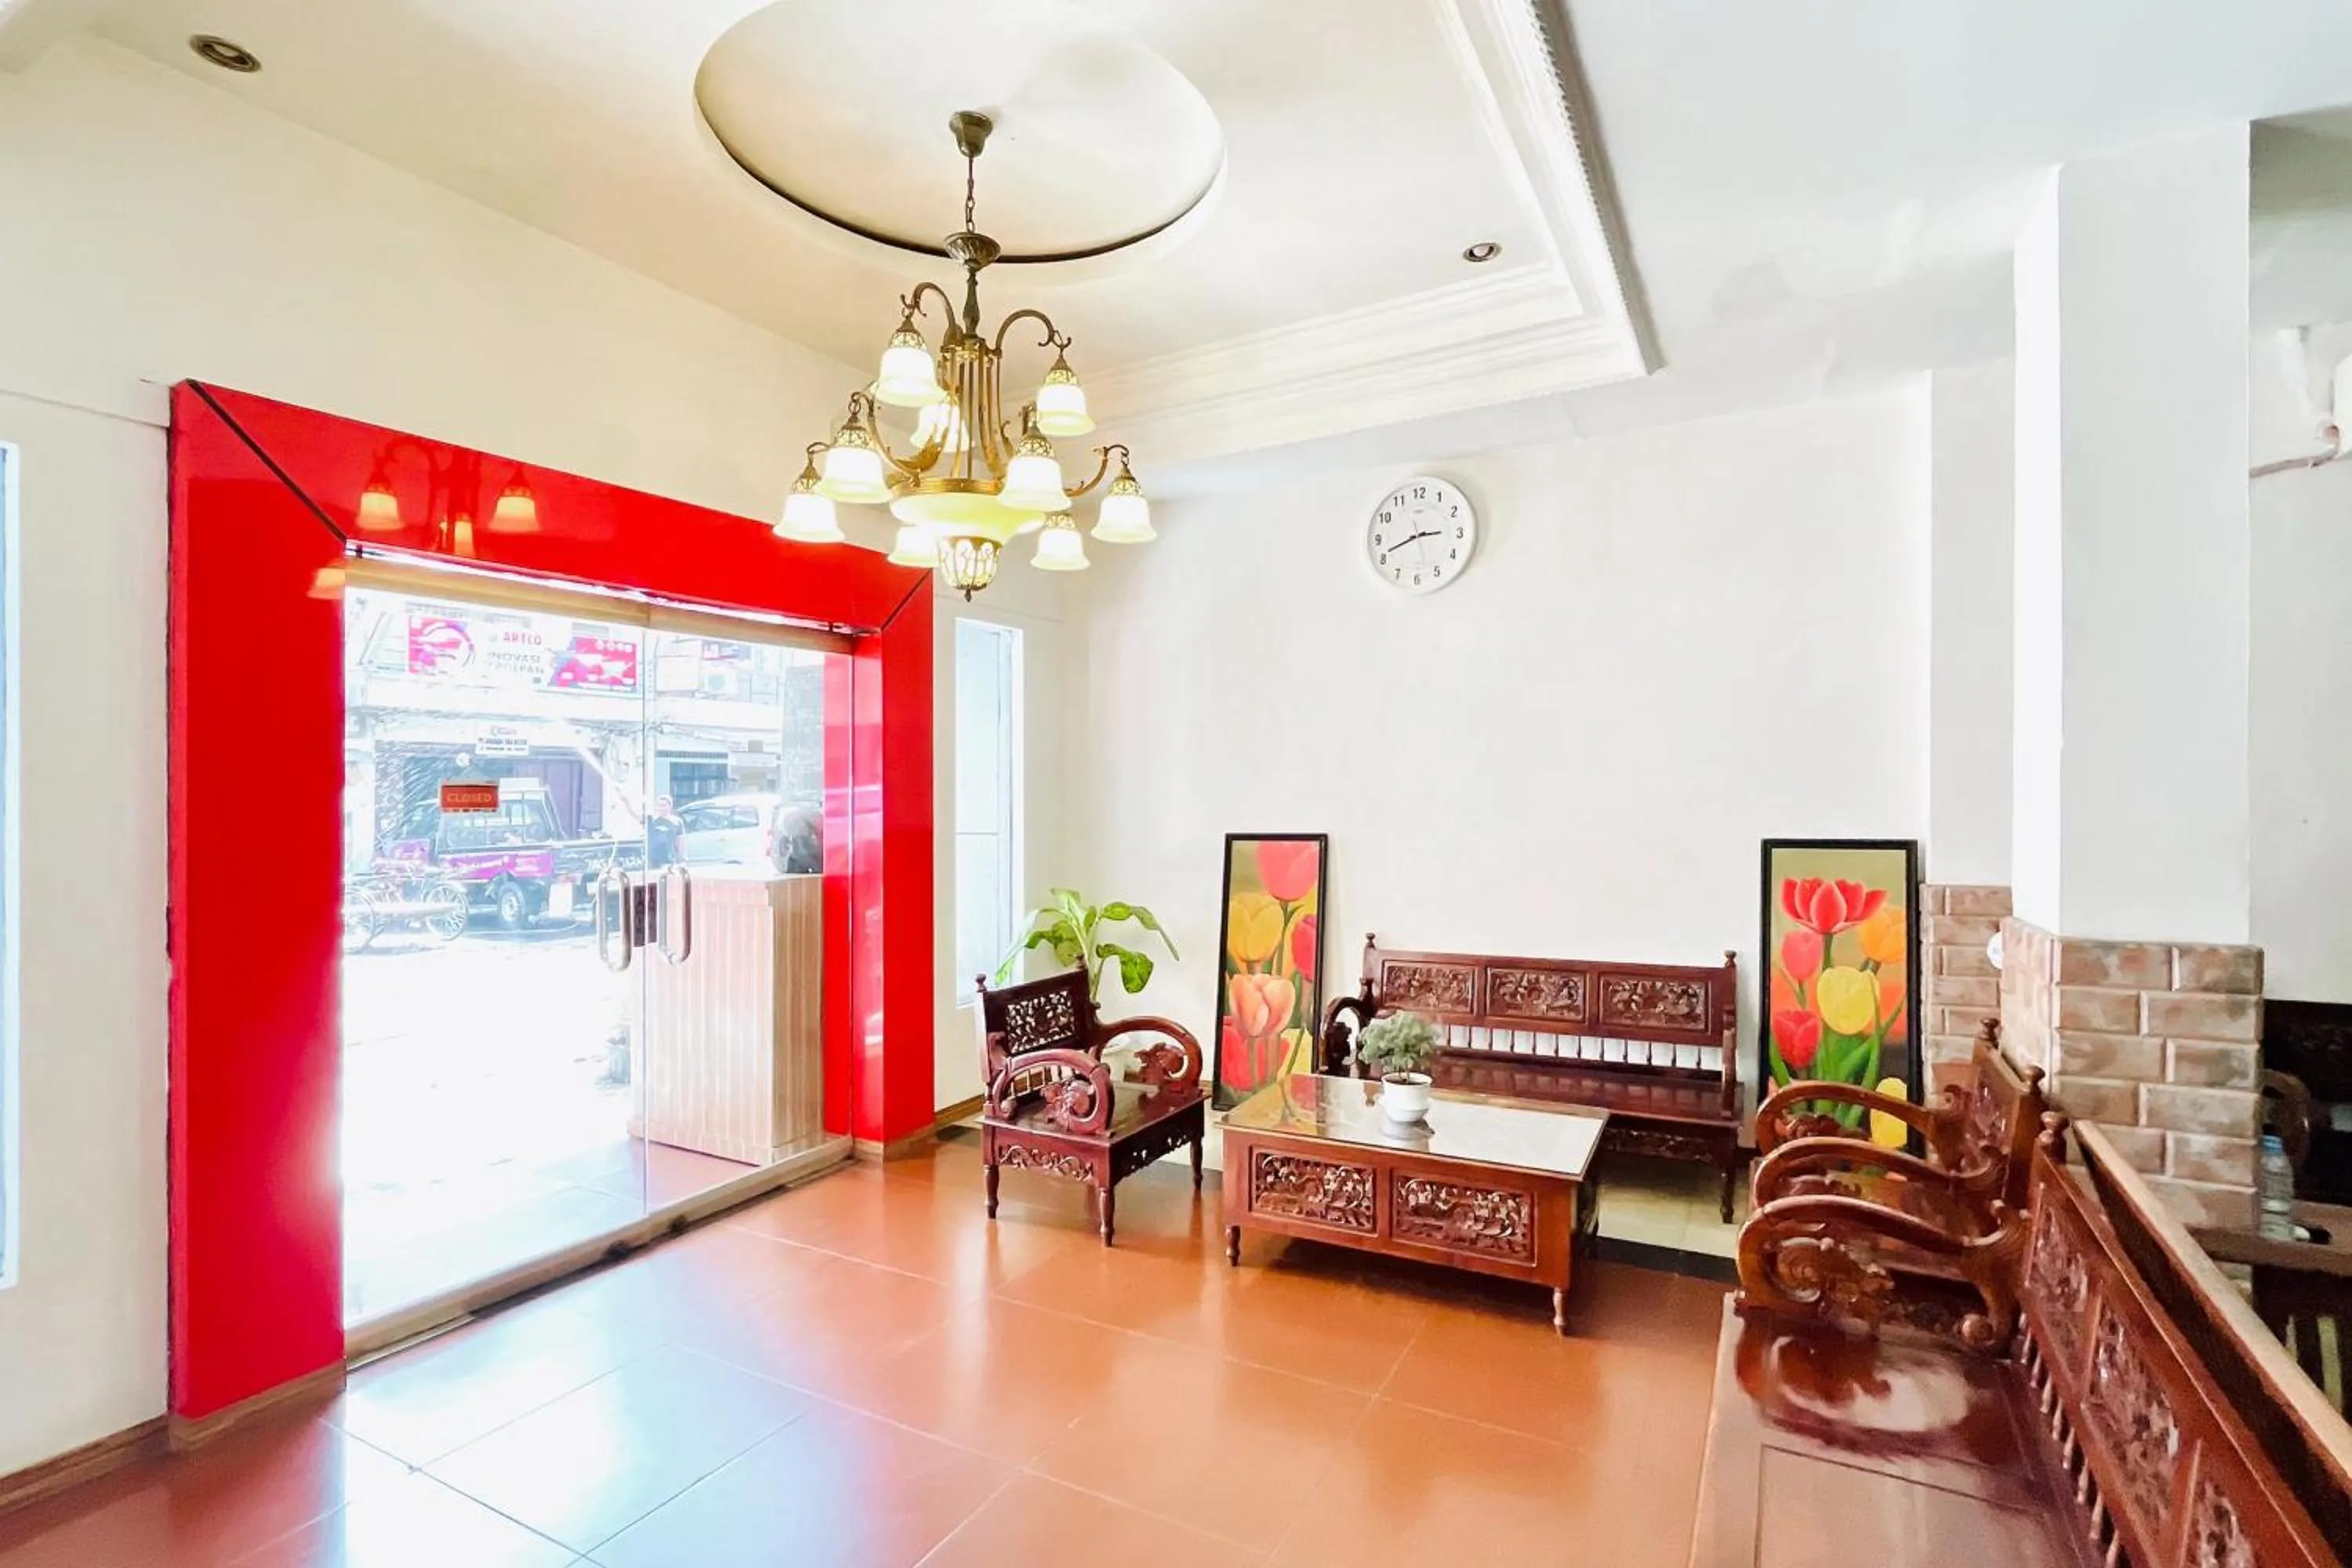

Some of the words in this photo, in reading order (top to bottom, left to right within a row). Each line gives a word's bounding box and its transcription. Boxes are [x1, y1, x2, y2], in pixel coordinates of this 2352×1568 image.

[1413, 487, 1426, 499] 12
[1436, 491, 1443, 503] 1
[1393, 495, 1405, 507] 11
[1450, 505, 1458, 518] 2
[1379, 512, 1392, 524] 10
[1456, 527, 1464, 539] 3
[1374, 534, 1382, 546] 9
[1379, 553, 1387, 564] 8
[1450, 548, 1457, 560] 4
[1394, 568, 1402, 579] 7
[1433, 565, 1441, 578] 5
[1413, 574, 1421, 586] 6
[446, 793, 492, 803] CLOSED
